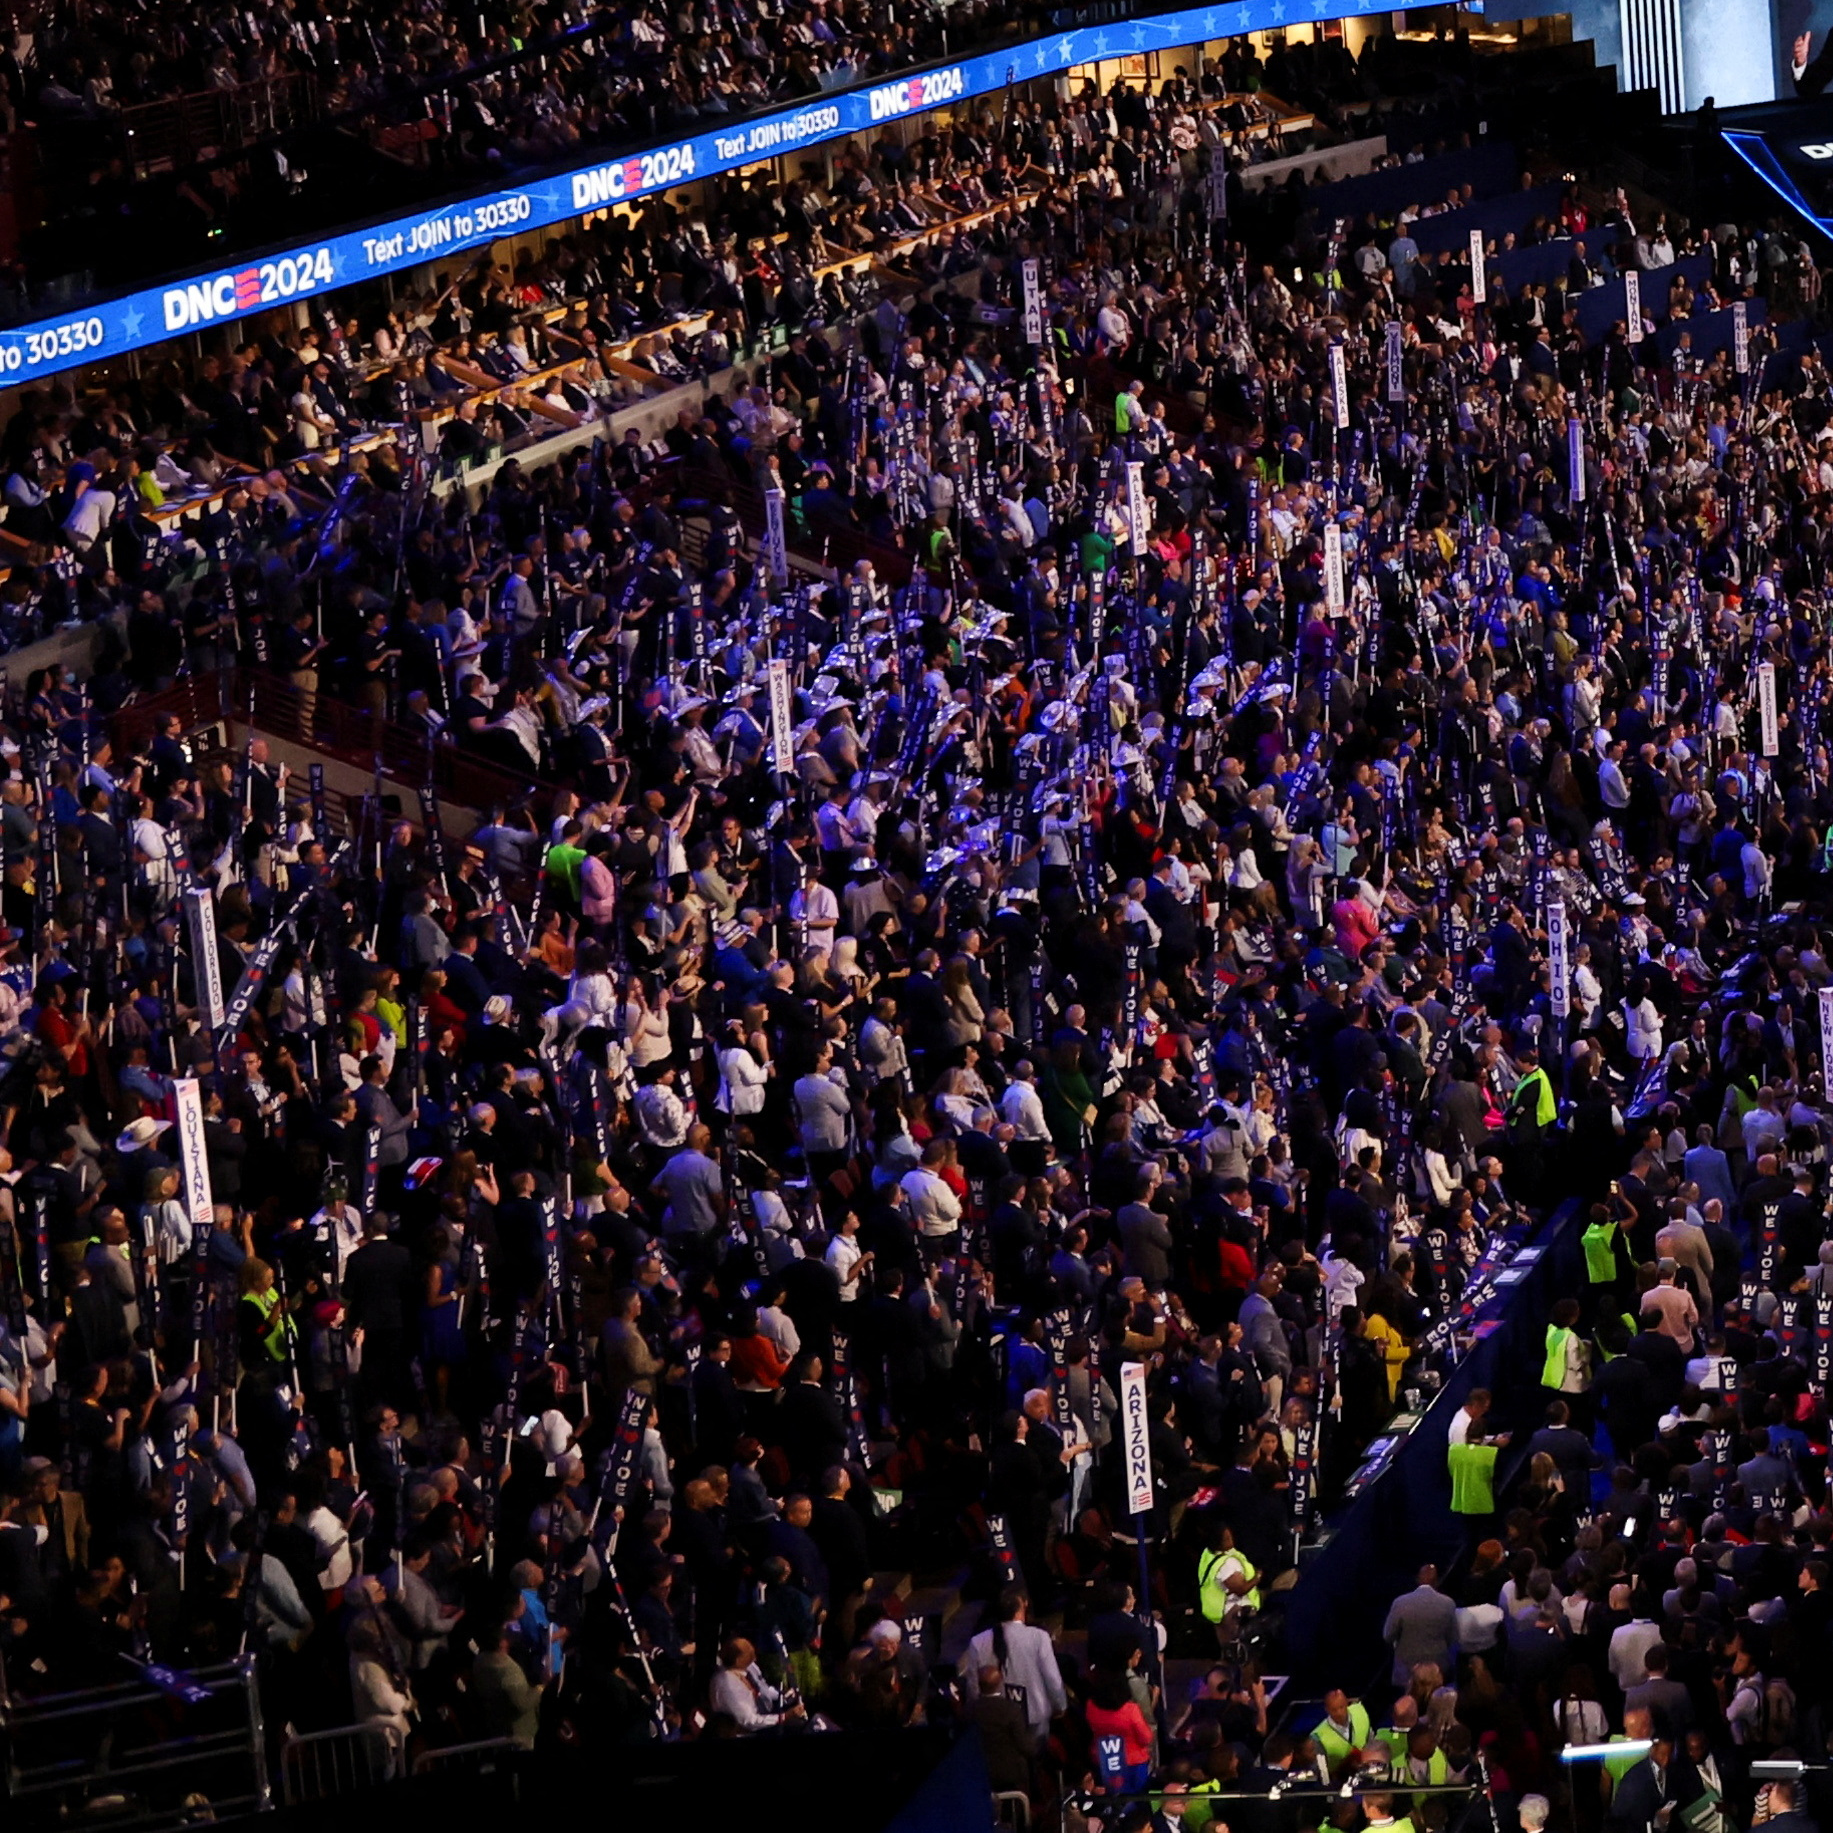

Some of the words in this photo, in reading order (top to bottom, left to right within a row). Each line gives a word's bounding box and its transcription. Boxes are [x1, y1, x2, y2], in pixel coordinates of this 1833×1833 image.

[363, 234, 403, 264] Text
[407, 218, 450, 253] JOIN
[454, 216, 472, 239] to
[476, 195, 529, 231] 30330
[1025, 271, 1039, 332] UTAH
[1629, 279, 1639, 334] MONTANA
[1336, 358, 1347, 415] ALASKA
[1132, 474, 1145, 540] ALABAMA
[1329, 537, 1338, 554] NEW
[1093, 573, 1103, 592] WE
[1092, 607, 1100, 637] JOE
[772, 673, 788, 756] WASHINGTON
[203, 907, 220, 1005] COLORADO
[1550, 918, 1562, 1002] OHIO
[1822, 1002, 1830, 1036] NEW
[1824, 1042, 1833, 1088] YORK
[185, 1099, 206, 1204] LOUISIANA
[174, 1425, 187, 1459] WE
[1128, 1384, 1147, 1491] ARIZONA
[1298, 1427, 1310, 1455] WE
[175, 1482, 186, 1530] JOE
[1295, 1476, 1305, 1514] JOE
